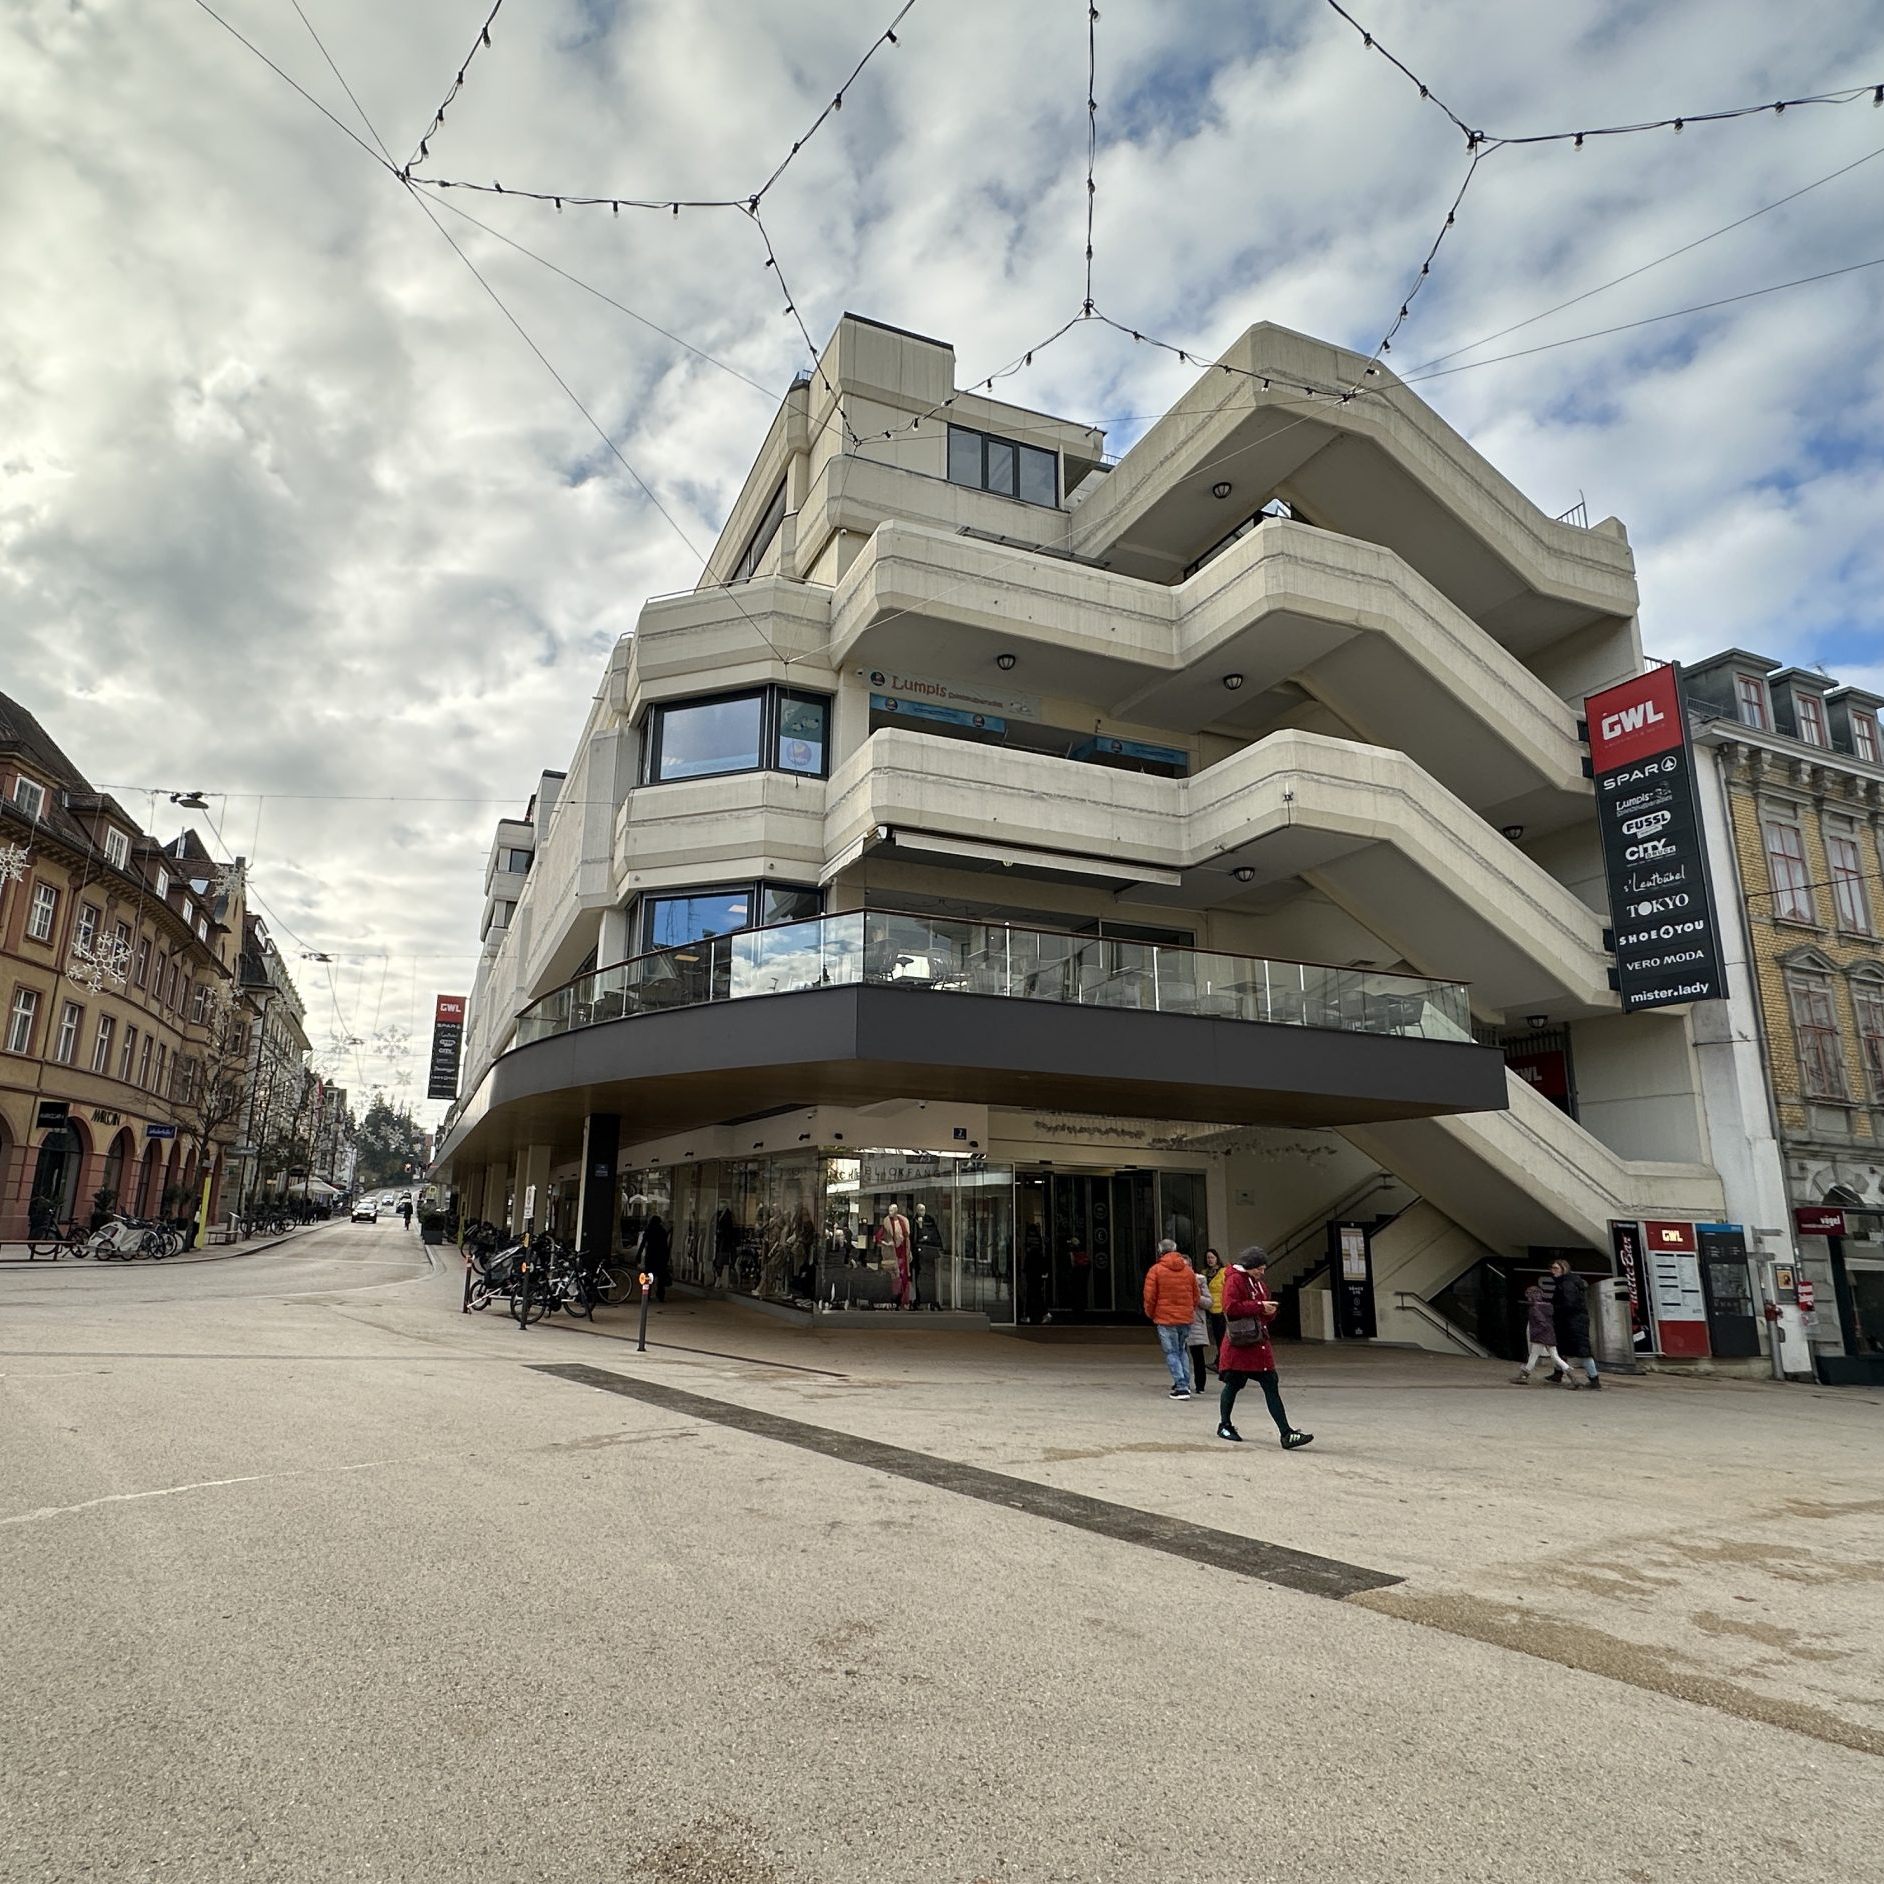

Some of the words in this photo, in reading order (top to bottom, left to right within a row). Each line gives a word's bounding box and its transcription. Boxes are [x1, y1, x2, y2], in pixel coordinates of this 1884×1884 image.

[892, 675, 947, 698] Lumpis
[1602, 700, 1664, 740] GWL
[1603, 763, 1659, 790] SPAR
[1626, 813, 1669, 833] FUSSL
[1625, 838, 1667, 861] CITY
[1627, 893, 1689, 918] TOKYO
[1626, 958, 1661, 972] VERO
[1663, 949, 1705, 965] MODA
[1630, 981, 1710, 1003] mister.lady
[440, 1003, 462, 1013] GWL
[1514, 1066, 1543, 1082] WL
[1661, 1229, 1684, 1243] GWL
